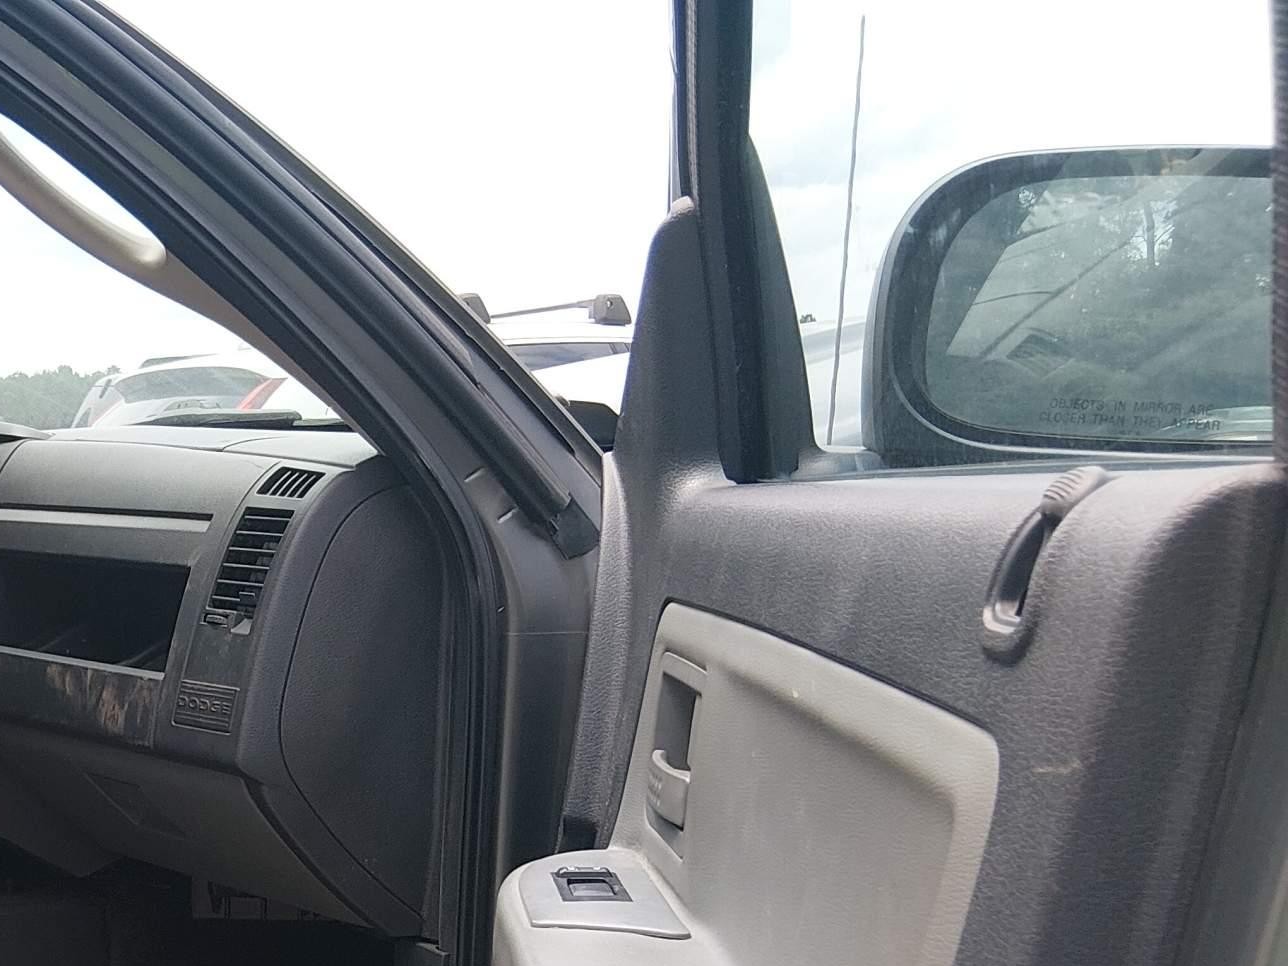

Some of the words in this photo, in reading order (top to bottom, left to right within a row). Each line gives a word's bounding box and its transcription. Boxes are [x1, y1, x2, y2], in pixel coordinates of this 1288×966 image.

[1050, 398, 1105, 411] OBJECTS
[1113, 400, 1126, 412] IN
[1134, 401, 1182, 414] MIRROR
[1188, 403, 1214, 416] ARE
[1039, 411, 1086, 424] CLOSER
[1093, 413, 1125, 427] THAN
[177, 695, 232, 714] DODGE
